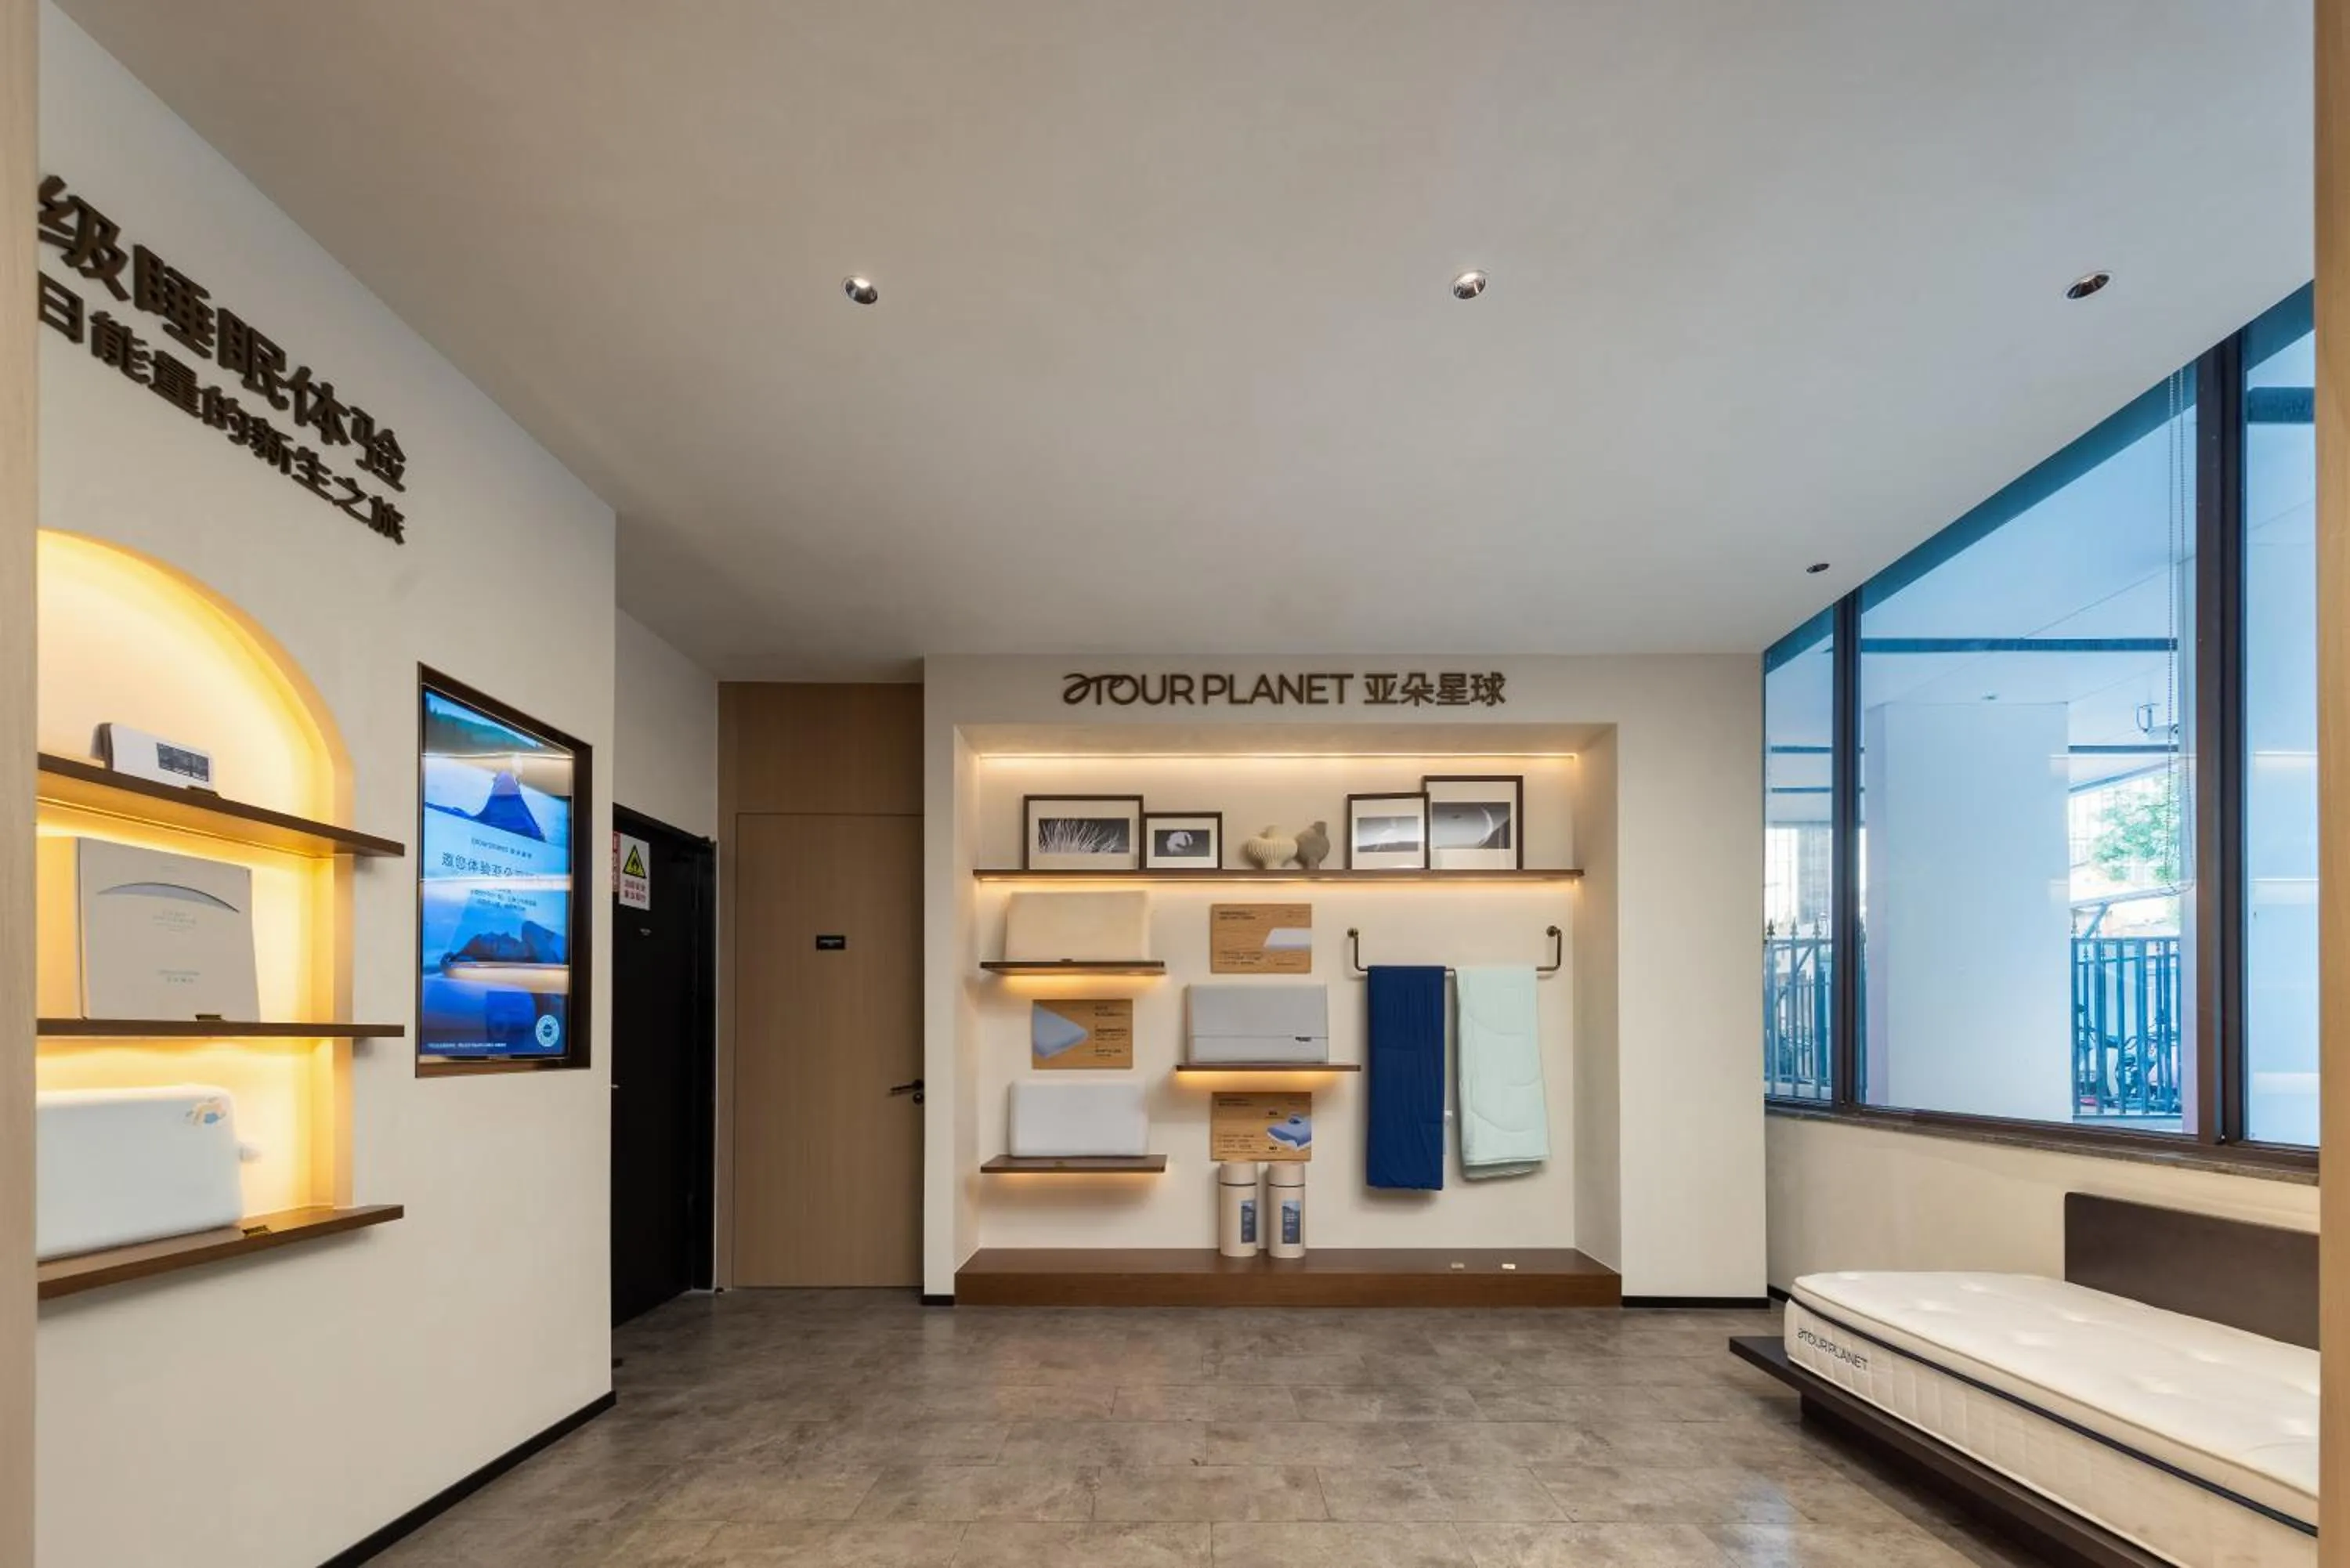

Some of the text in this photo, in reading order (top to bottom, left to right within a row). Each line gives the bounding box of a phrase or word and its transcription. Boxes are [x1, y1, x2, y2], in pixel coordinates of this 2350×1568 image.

[38, 175, 407, 492] 级睡眠体验
[1202, 673, 1354, 705] PLANET
[1364, 671, 1506, 706] 亚朵星球
